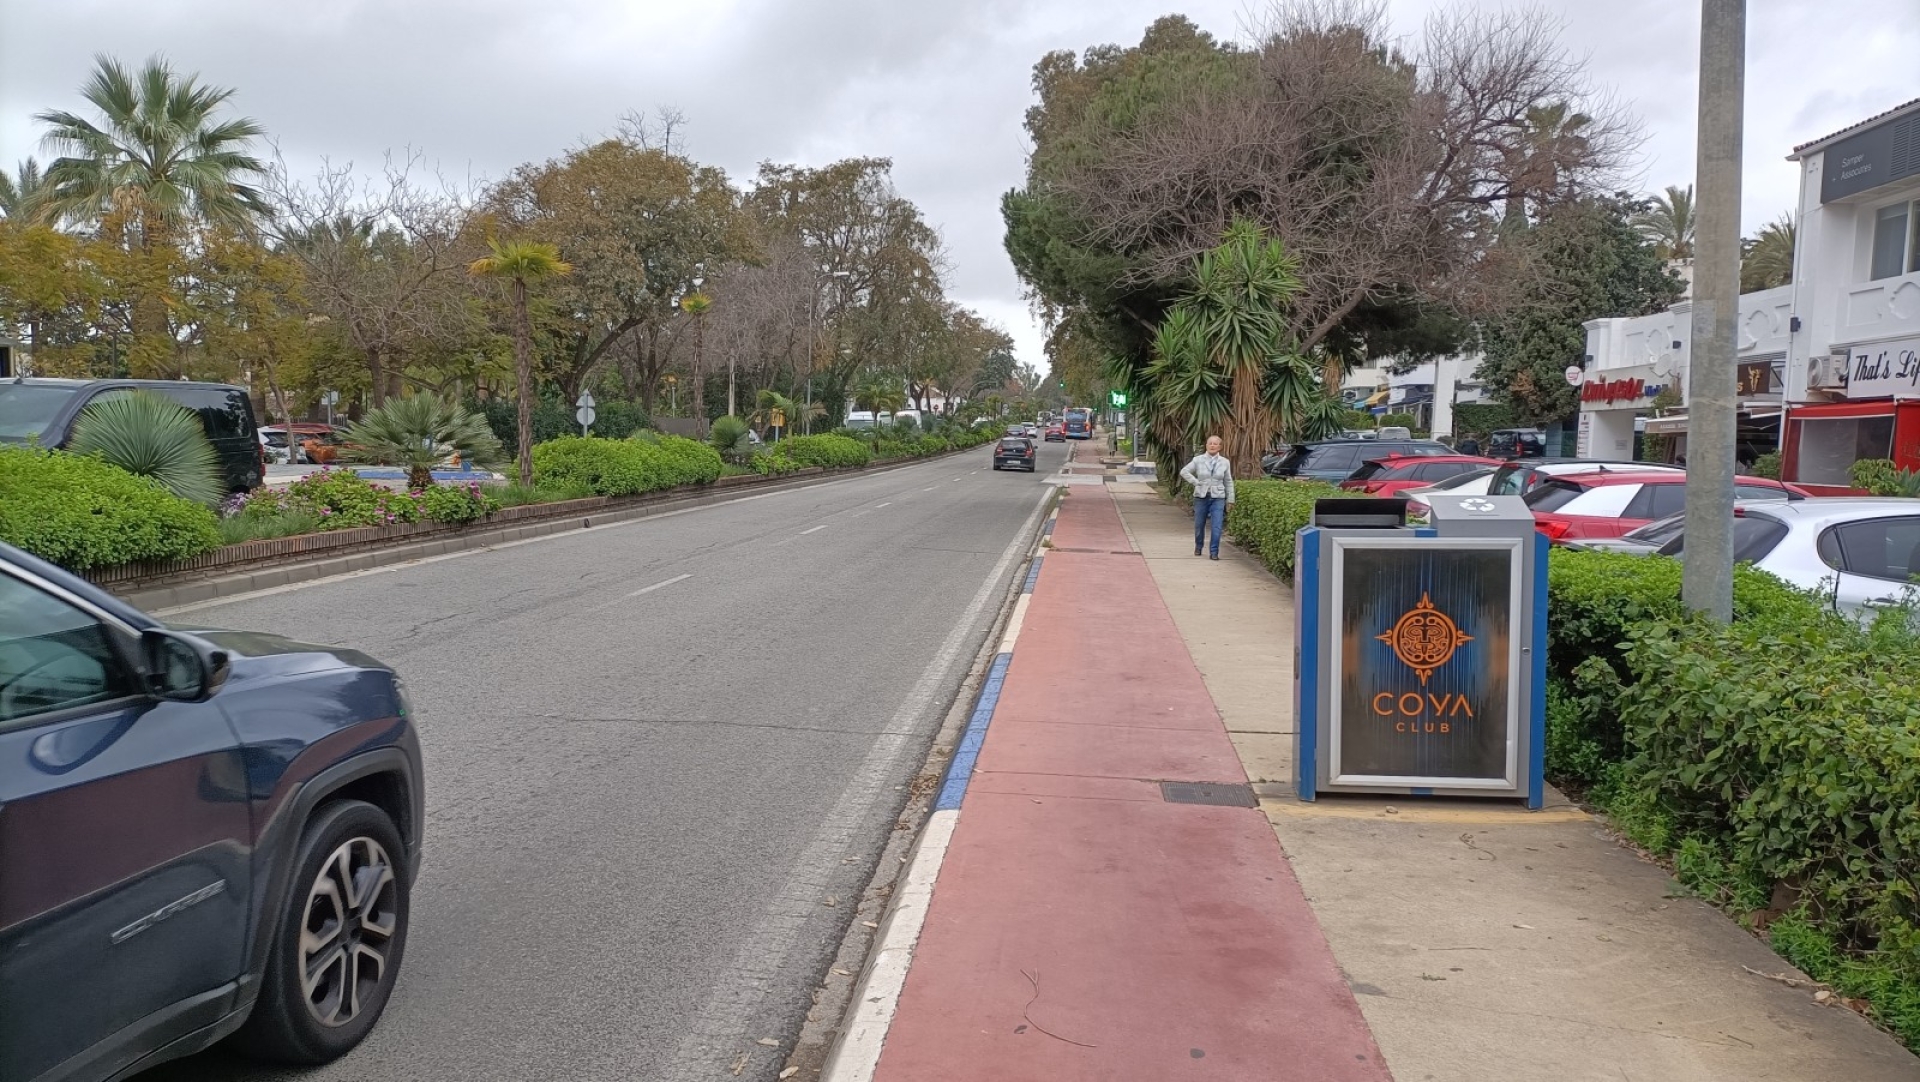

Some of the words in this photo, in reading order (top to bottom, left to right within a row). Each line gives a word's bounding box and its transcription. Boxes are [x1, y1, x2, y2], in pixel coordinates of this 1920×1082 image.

[1853, 350, 1891, 382] That's
[1373, 692, 1473, 717] COYA
[1396, 722, 1450, 733] CLUB
